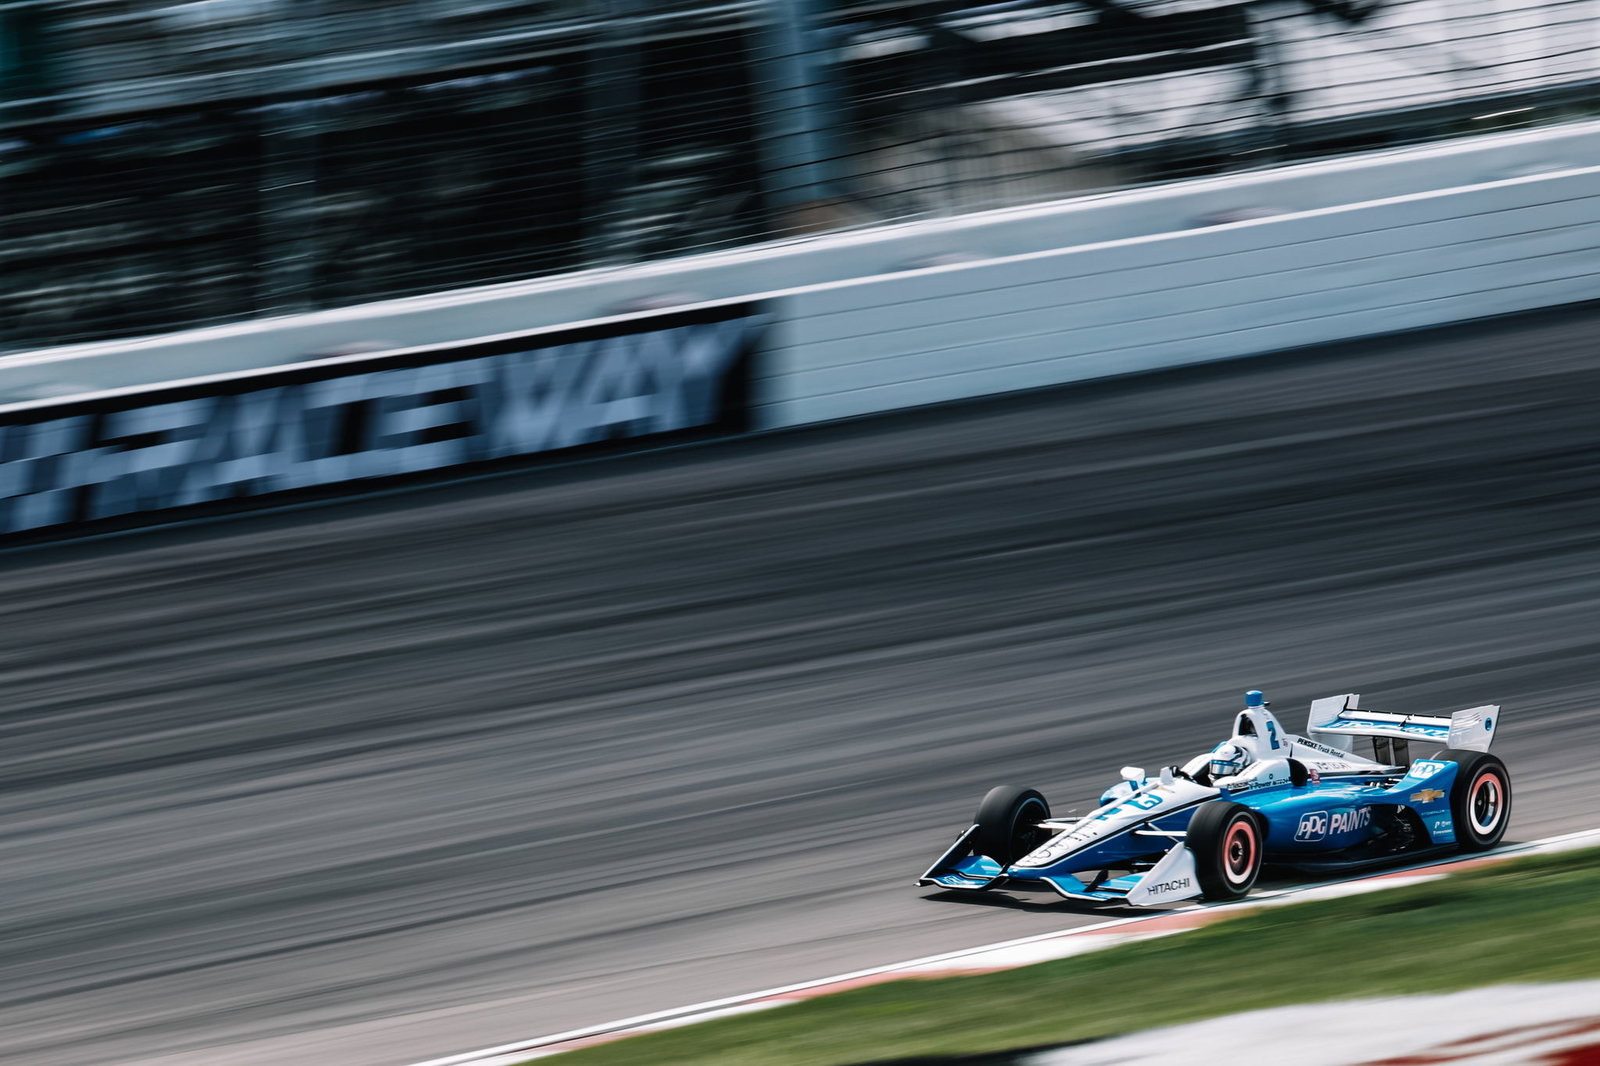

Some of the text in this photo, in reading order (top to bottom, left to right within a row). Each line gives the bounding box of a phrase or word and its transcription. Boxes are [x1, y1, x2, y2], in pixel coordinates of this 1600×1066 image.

[1266, 720, 1280, 750] 2
[1297, 737, 1318, 749] PENSKE
[1298, 806, 1372, 840] PPG PAINTS
[1147, 877, 1190, 896] HITACHI
